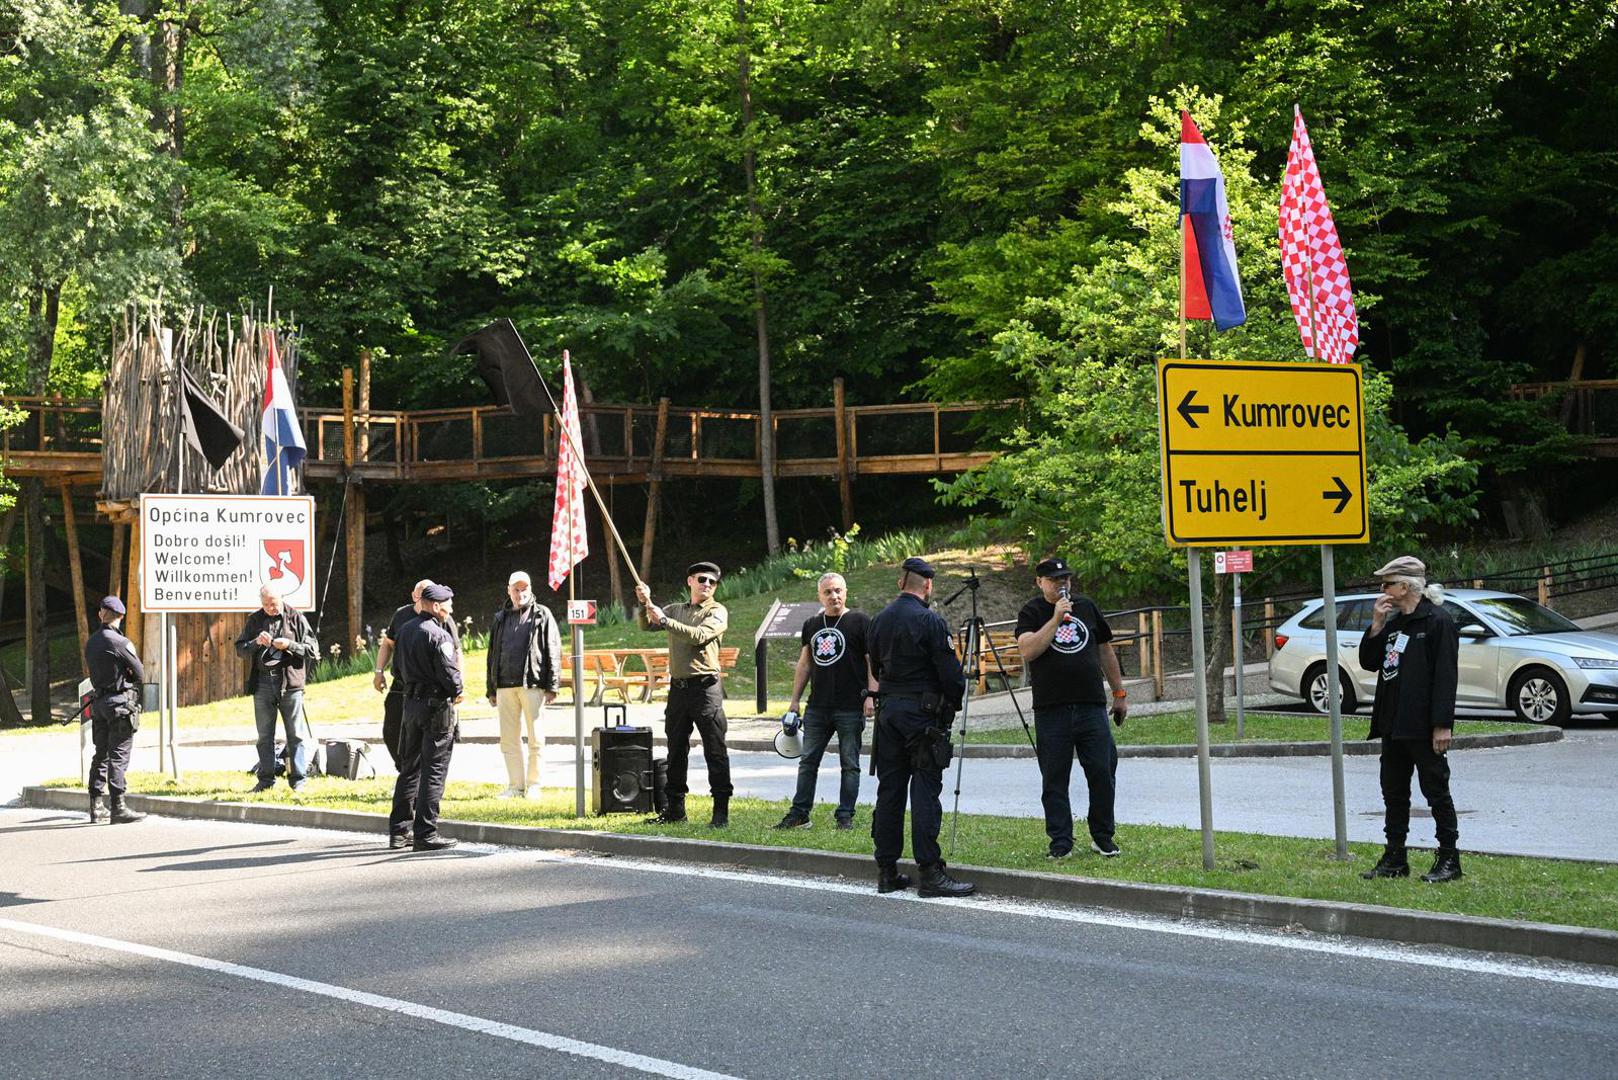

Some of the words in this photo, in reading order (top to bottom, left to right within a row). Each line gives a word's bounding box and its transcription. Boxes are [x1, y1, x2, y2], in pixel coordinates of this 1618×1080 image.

[1222, 393, 1351, 429] Kumrovec
[1179, 479, 1267, 521] Tuhelj
[150, 507, 209, 527] Općina
[217, 508, 305, 523] Kumrovec
[154, 534, 199, 547] Dobro
[205, 534, 246, 547] došli!
[155, 552, 230, 565] Welcome!
[155, 570, 253, 583] Willkommen!
[154, 588, 238, 601] Benvenuti!
[572, 609, 584, 618] 151
